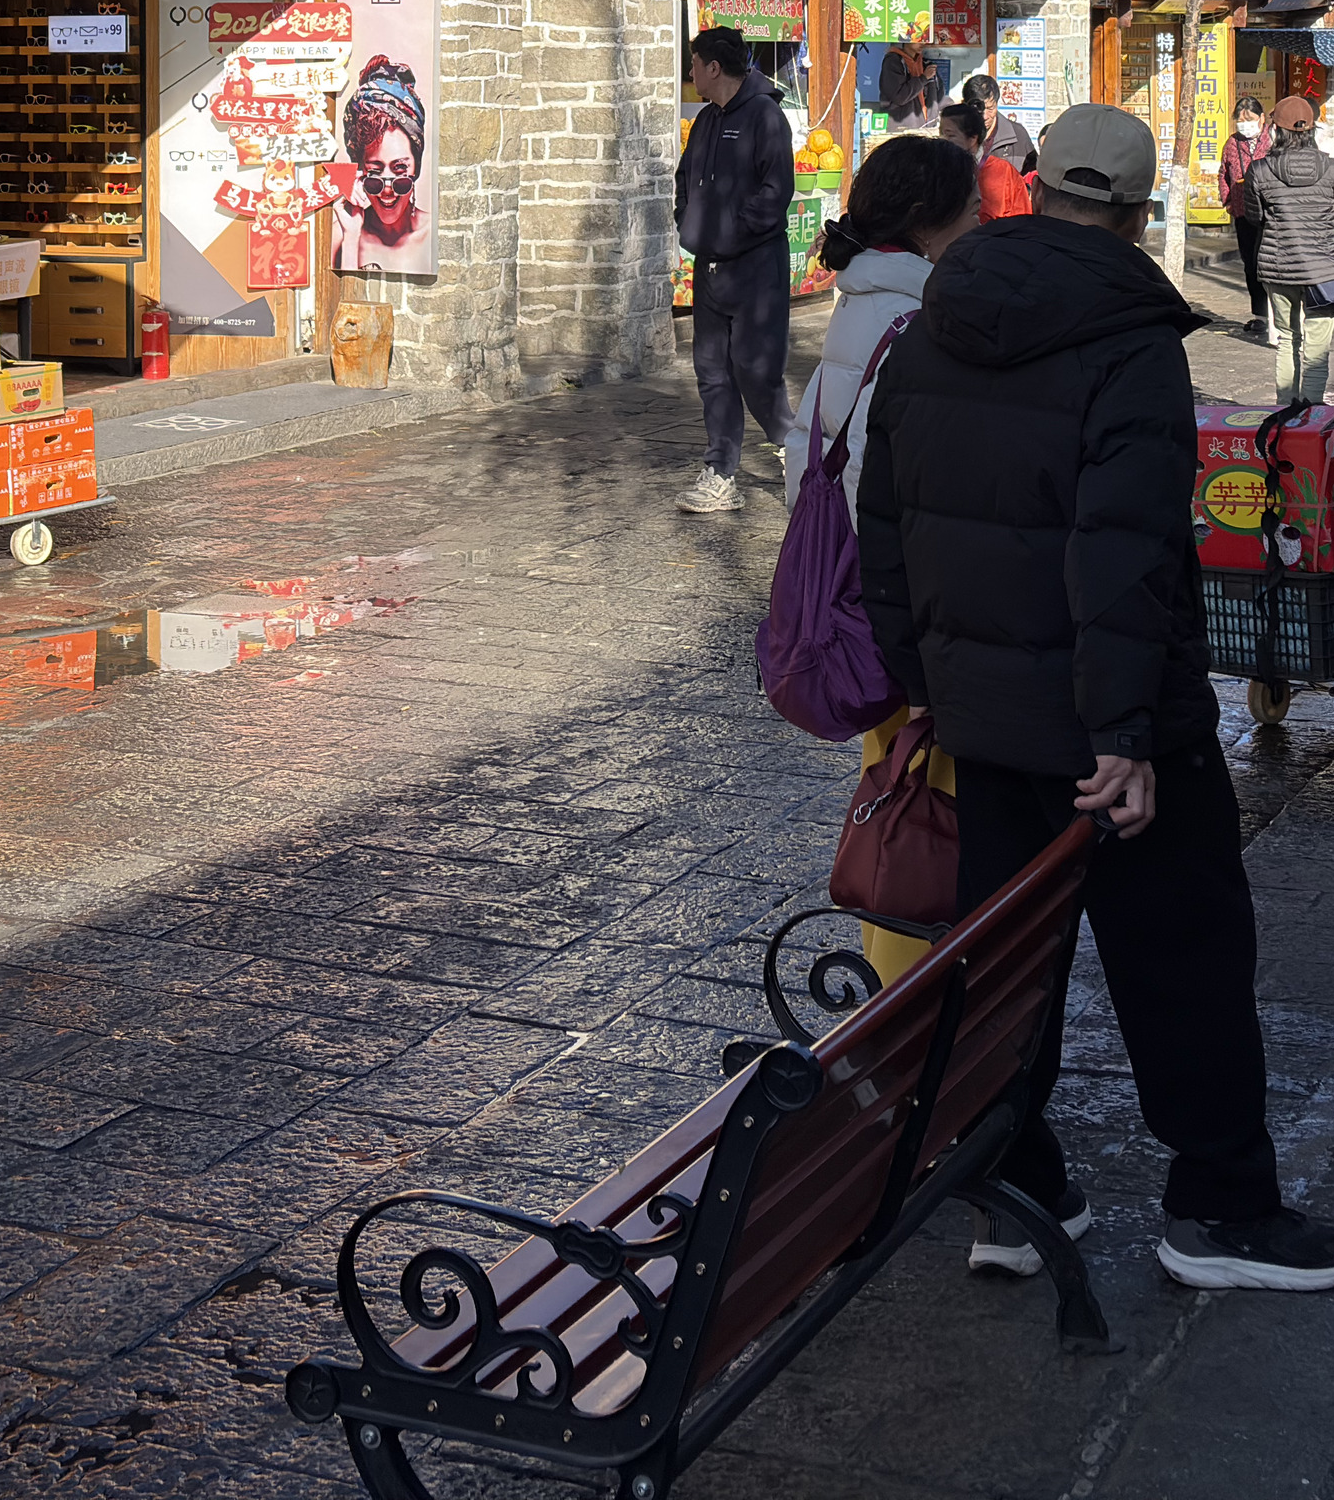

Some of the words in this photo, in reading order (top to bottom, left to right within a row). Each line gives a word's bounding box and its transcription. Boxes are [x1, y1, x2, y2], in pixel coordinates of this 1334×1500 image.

[231, 46, 266, 55] HAPPY
[273, 46, 295, 55] NEW
[302, 46, 329, 55] YEAR
[1196, 31, 1219, 96] 禁止向
[1157, 32, 1175, 112] 特许授权
[217, 101, 307, 120] 我在这里等你
[1196, 118, 1218, 162] 出售
[1212, 481, 1269, 517] 芳芳
